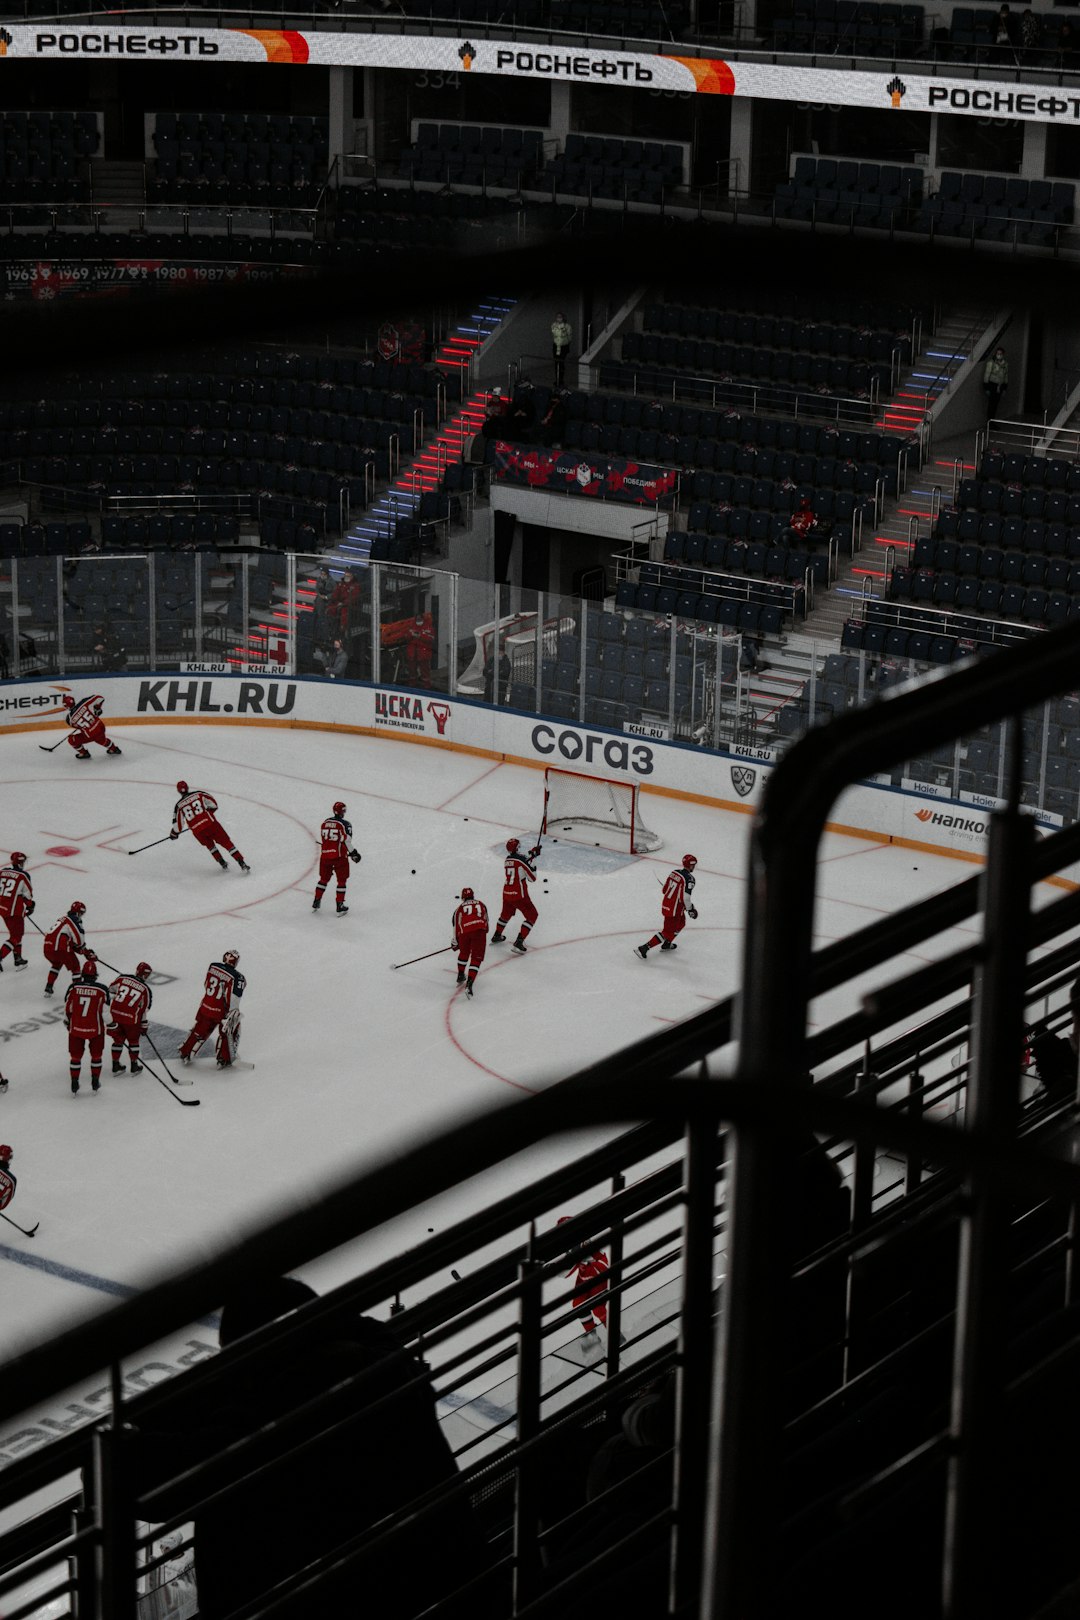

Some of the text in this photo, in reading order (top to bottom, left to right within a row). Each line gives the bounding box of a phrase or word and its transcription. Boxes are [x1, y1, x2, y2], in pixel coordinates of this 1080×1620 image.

[36, 34, 219, 55] РОСНЕФТЬ
[497, 50, 654, 82] РОСНЕФТЬ
[6, 268, 38, 281] 1963
[58, 268, 89, 281] 1969
[154, 267, 187, 280] 1980
[193, 268, 225, 281] 1987
[187, 663, 225, 672] KHL.RU
[248, 665, 286, 675] KHL.RU
[137, 681, 297, 715] KHL.RU
[375, 692, 424, 722] ЦСКА
[628, 724, 664, 739] KHL.RU
[735, 746, 771, 760] KHL.RU
[914, 782, 938, 796] Haier
[972, 794, 997, 808] Haier
[115, 985, 142, 1008] 37
[79, 996, 92, 1017] 7
